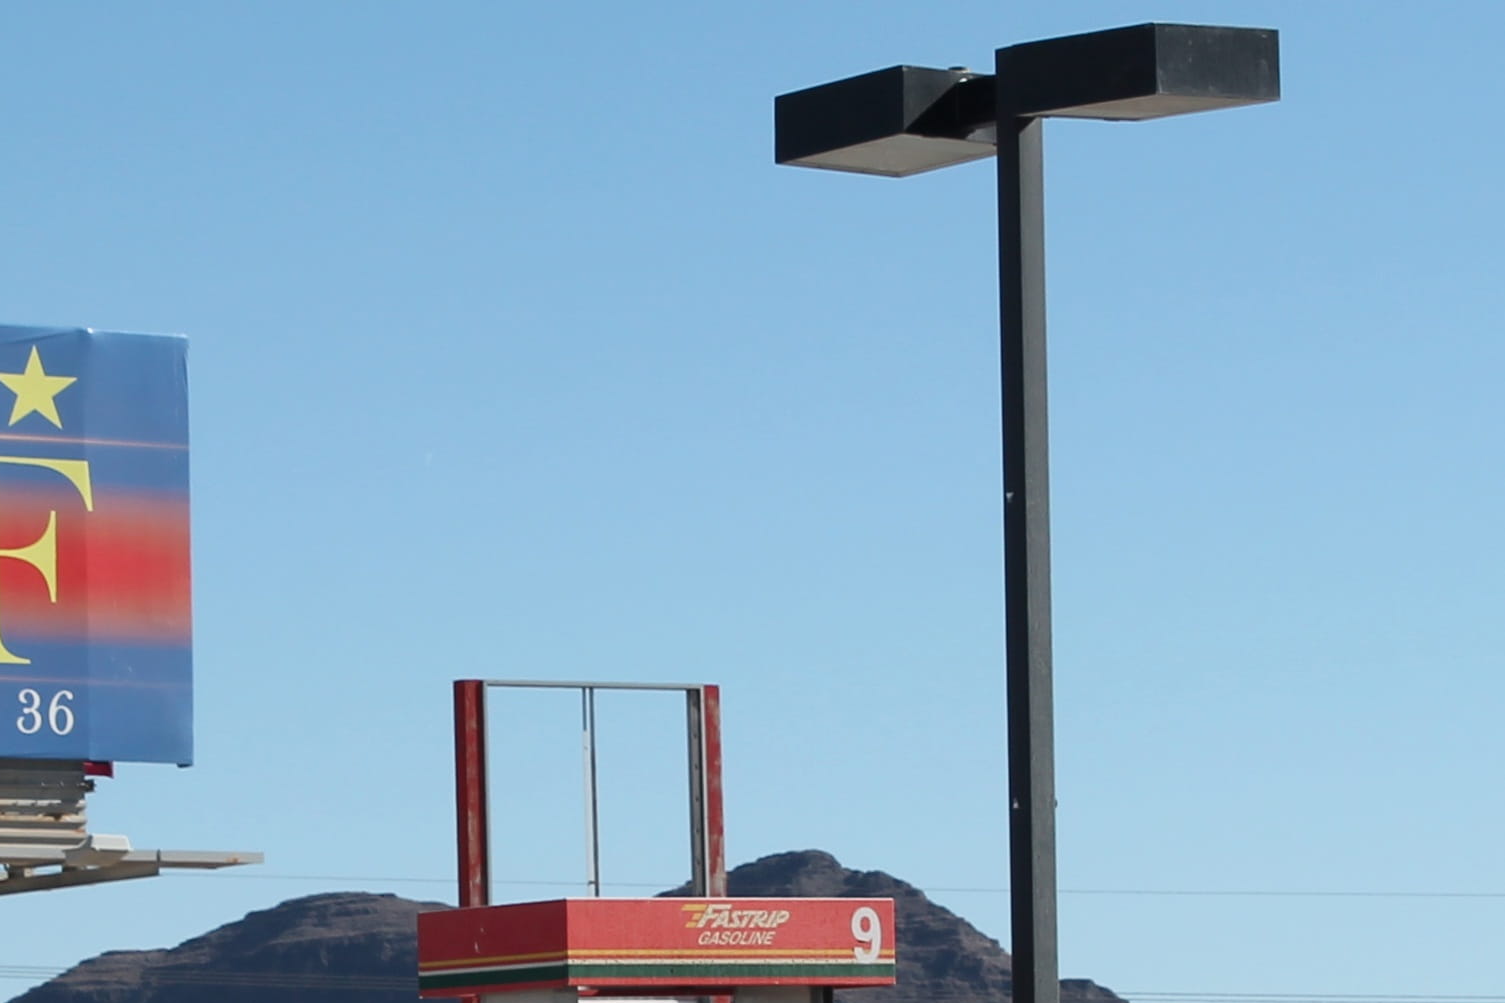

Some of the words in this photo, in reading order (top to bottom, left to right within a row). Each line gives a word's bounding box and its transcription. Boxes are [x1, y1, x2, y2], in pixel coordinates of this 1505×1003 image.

[16, 688, 76, 736] 36
[696, 903, 790, 929] FASTRIP
[698, 930, 777, 946] GASOLINE
[850, 906, 883, 964] 9
